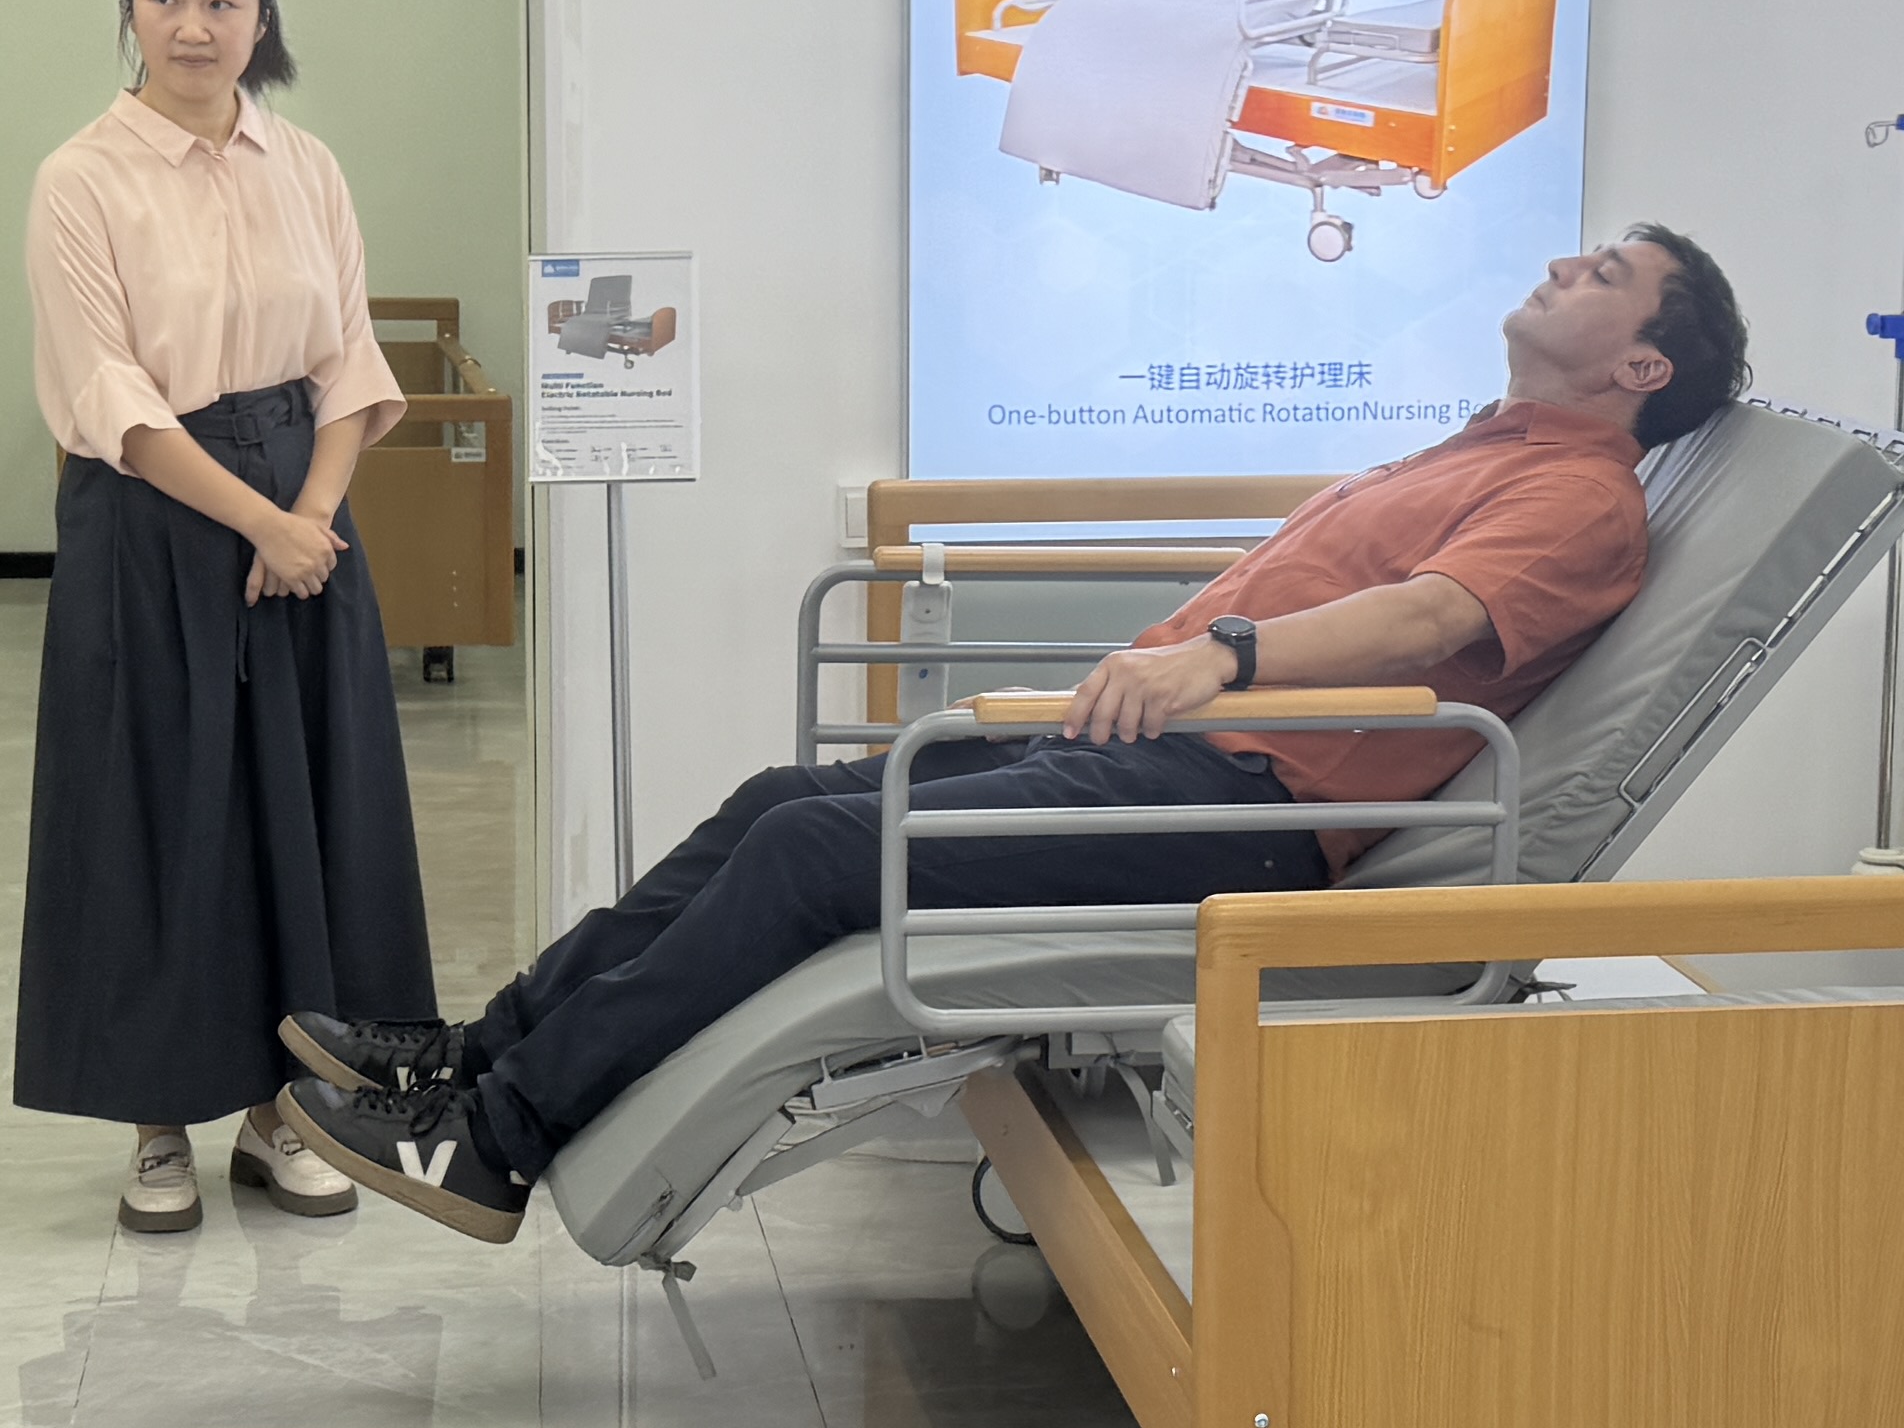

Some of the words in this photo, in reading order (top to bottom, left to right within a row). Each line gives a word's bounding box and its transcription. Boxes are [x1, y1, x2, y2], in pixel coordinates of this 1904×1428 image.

[1118, 359, 1373, 392] 一键自动旋转护理床
[987, 403, 1126, 426] One-button
[1132, 402, 1256, 425] Automatic
